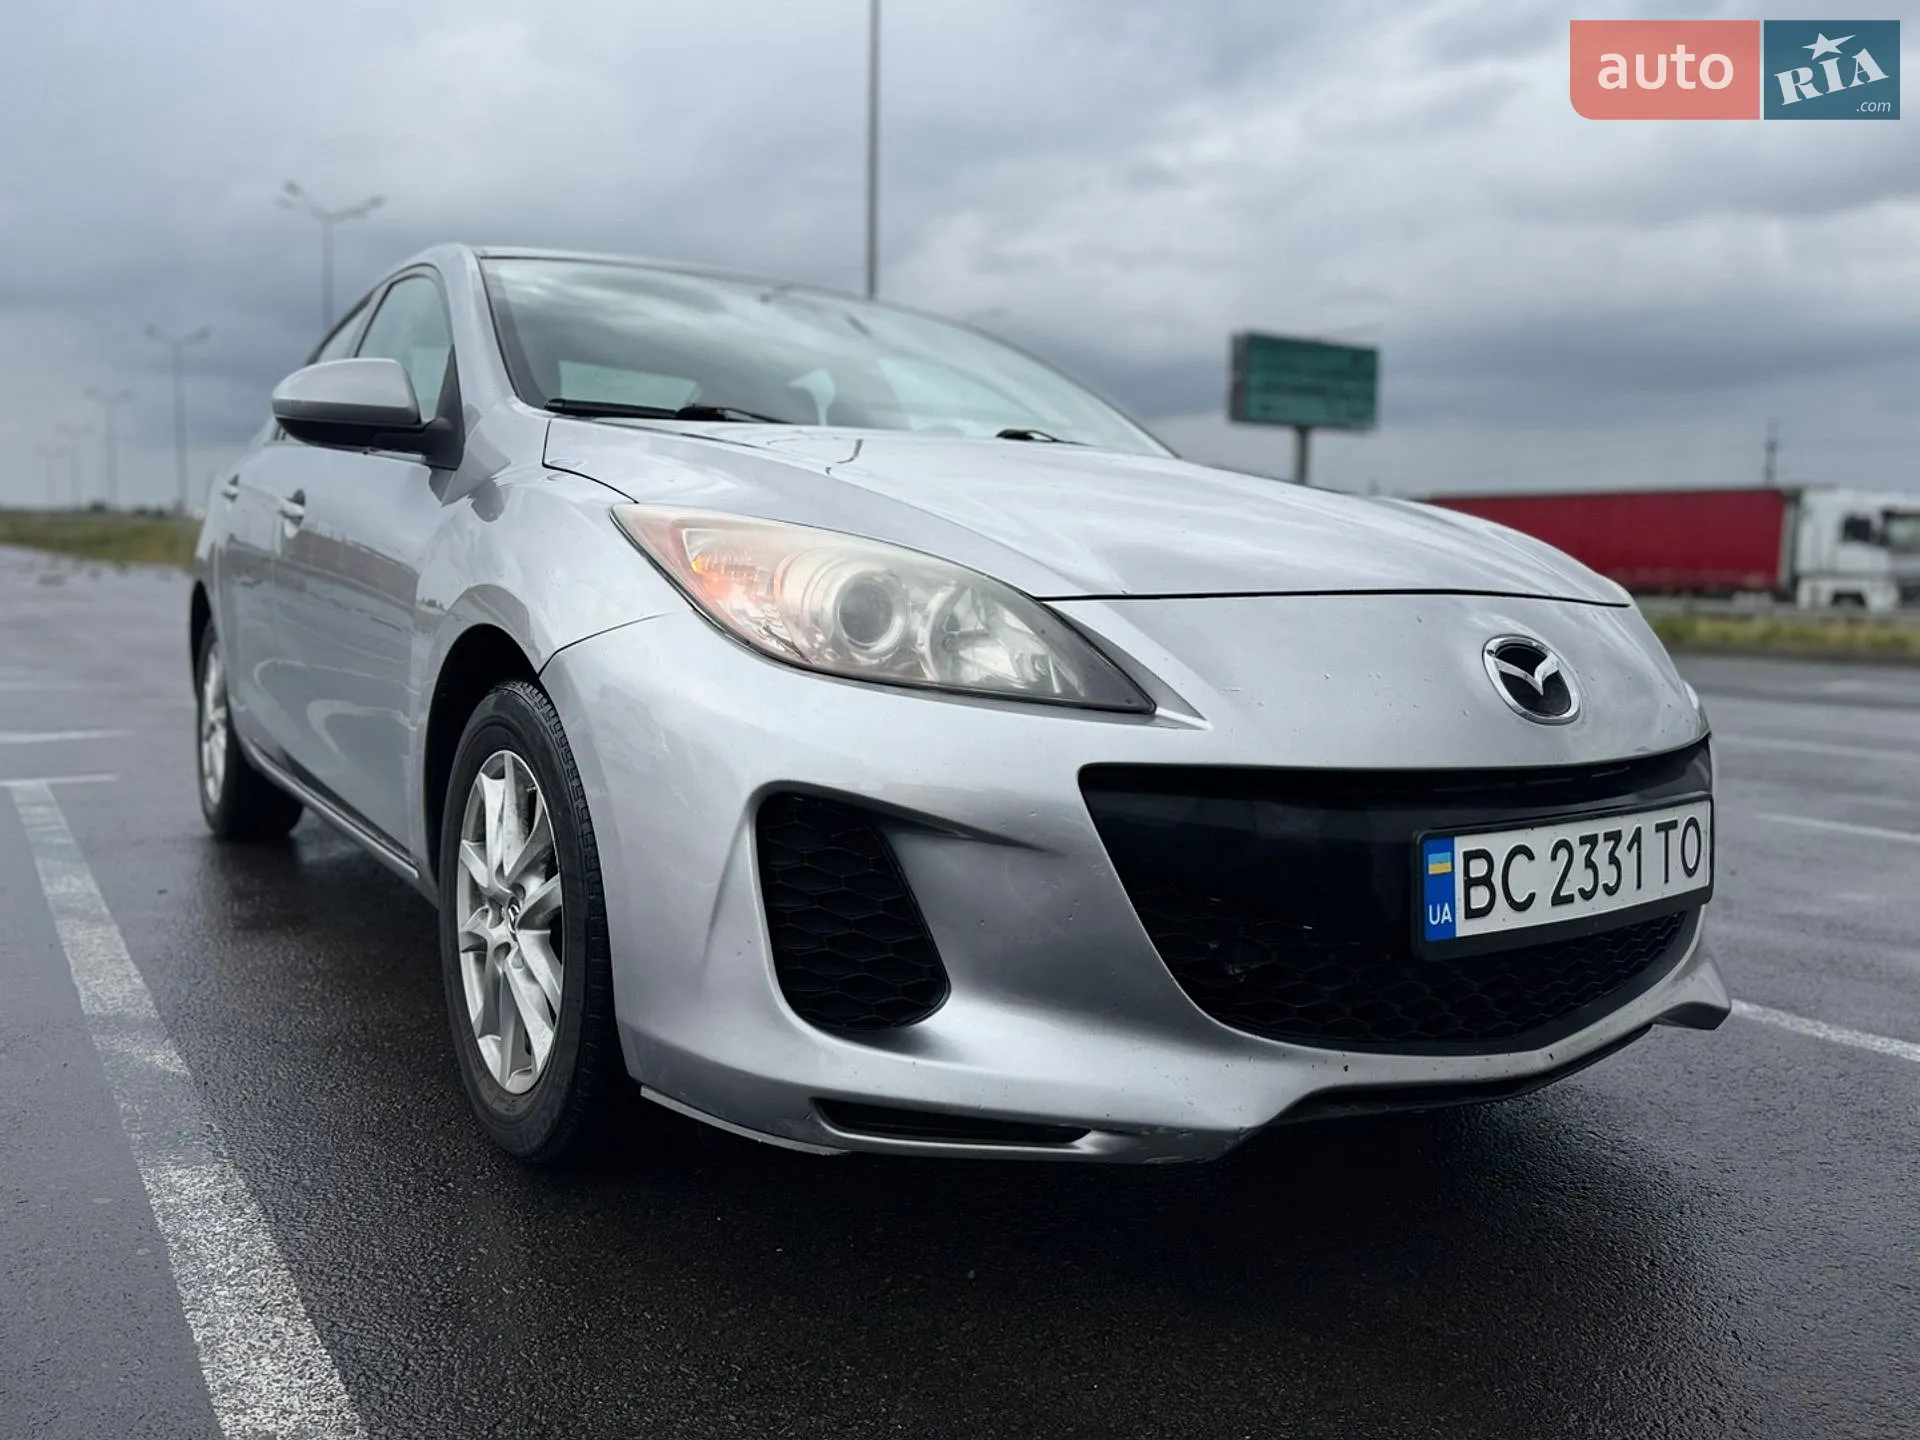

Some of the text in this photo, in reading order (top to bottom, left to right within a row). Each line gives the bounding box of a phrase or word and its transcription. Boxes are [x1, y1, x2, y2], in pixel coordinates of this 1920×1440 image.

[1462, 816, 1701, 920] BC 2331 TO
[1428, 902, 1453, 926] UA
